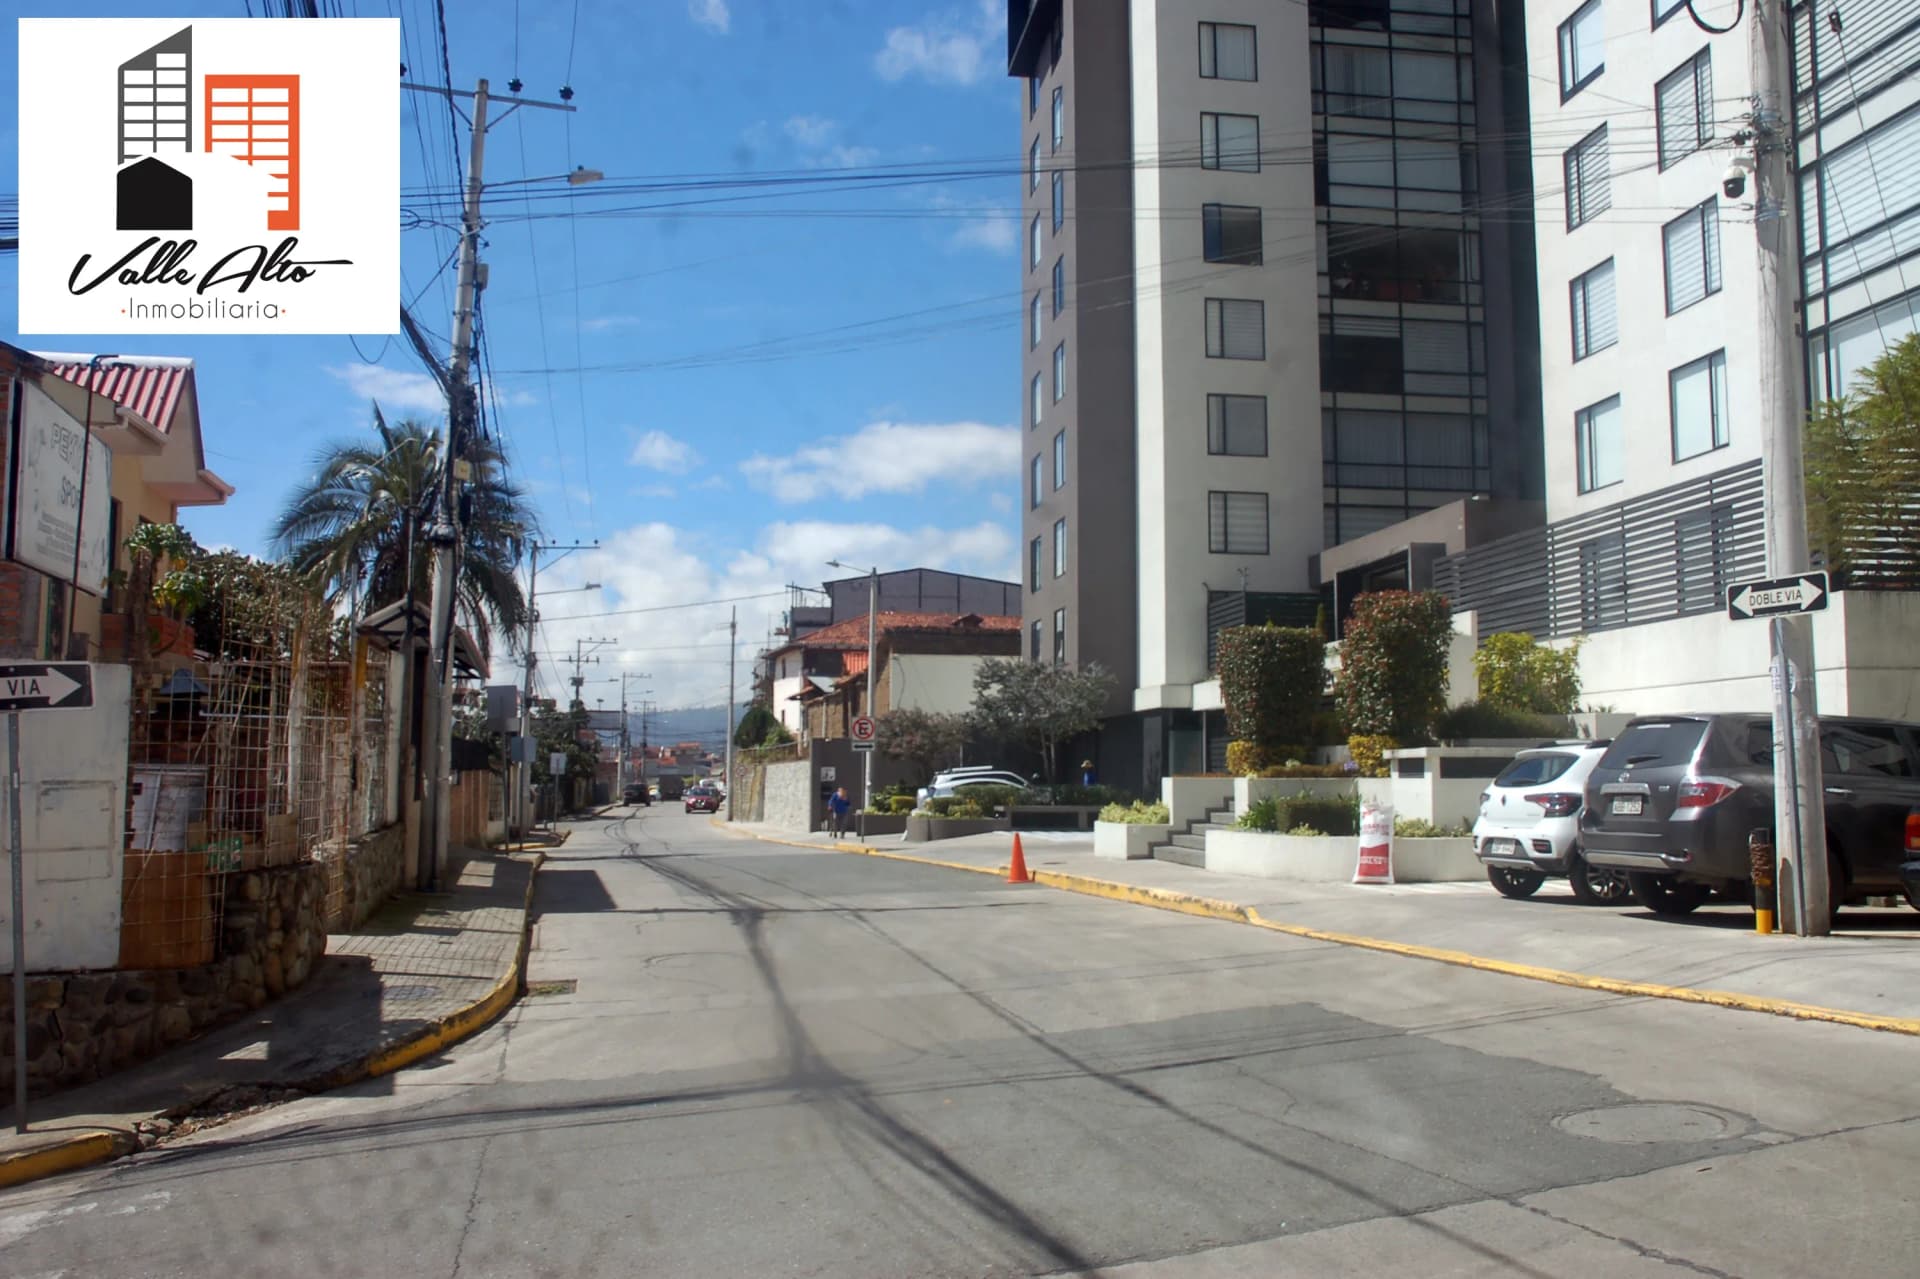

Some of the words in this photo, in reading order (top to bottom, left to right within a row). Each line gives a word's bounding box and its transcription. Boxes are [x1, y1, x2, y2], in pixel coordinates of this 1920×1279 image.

[1749, 591, 1783, 607] DOBLE
[1784, 589, 1803, 601] VIA
[7, 678, 41, 696] VIA
